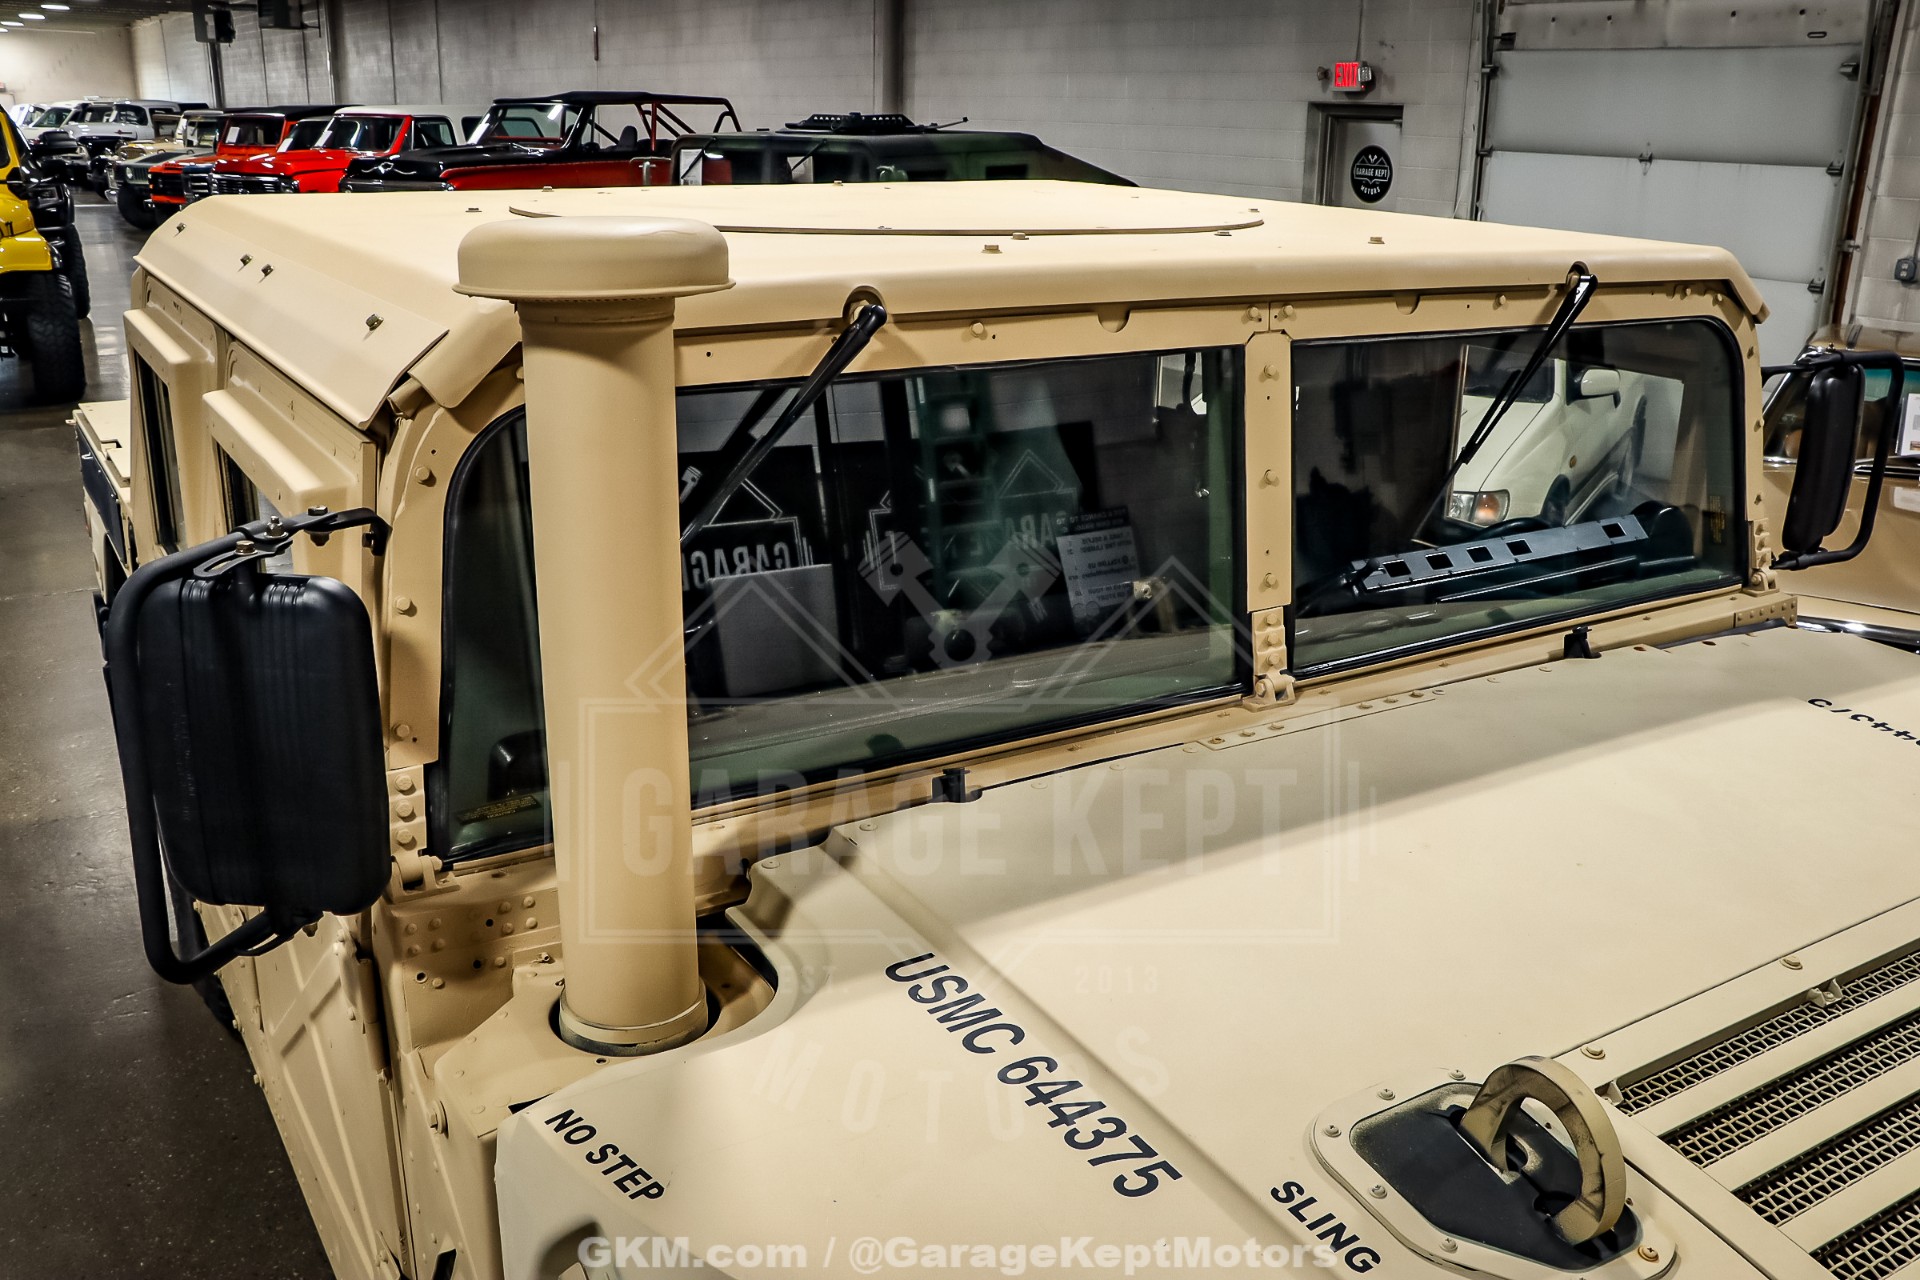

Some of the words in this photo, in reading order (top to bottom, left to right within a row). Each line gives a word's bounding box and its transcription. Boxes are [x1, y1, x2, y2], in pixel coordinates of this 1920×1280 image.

[1334, 62, 1360, 87] EXIT
[1356, 167, 1374, 177] GARAGE
[1375, 169, 1387, 178] KEPT
[1360, 185, 1380, 195] MOTORS
[885, 952, 1026, 1055] USMC
[996, 1056, 1184, 1198] 644375
[545, 1108, 597, 1145] NO
[585, 1143, 665, 1200] STEP
[1270, 1181, 1381, 1274] SLING
